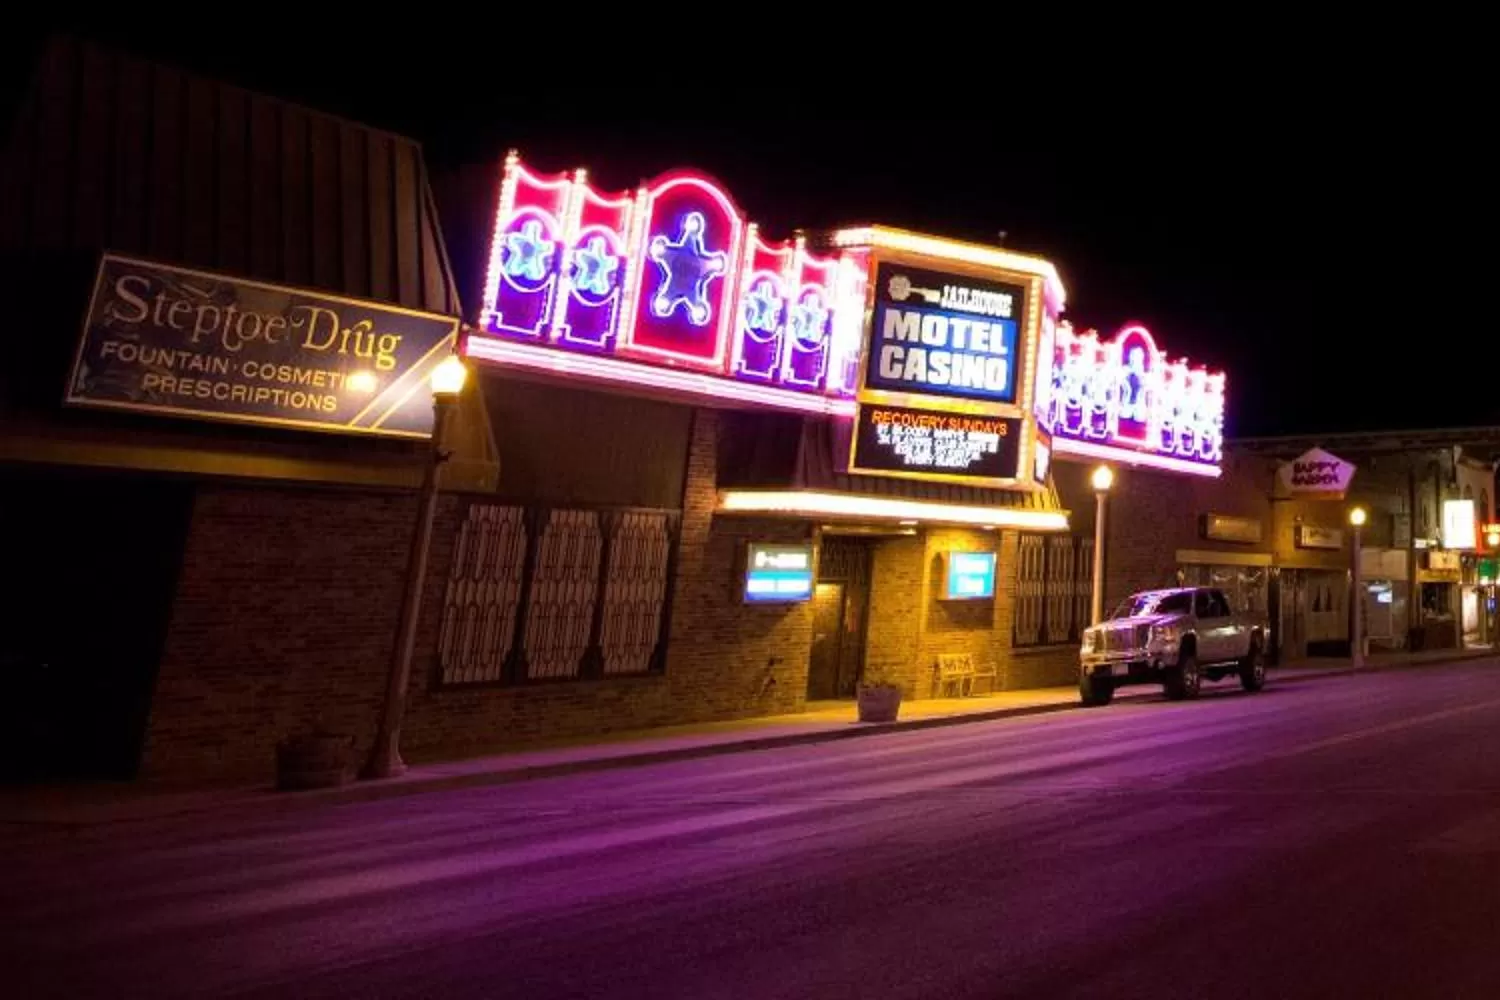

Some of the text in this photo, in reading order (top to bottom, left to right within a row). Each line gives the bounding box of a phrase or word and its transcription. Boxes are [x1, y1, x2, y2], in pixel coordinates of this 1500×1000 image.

[111, 275, 403, 371] Steptoe Drug
[883, 308, 1008, 355] MOTEL
[101, 341, 376, 392] FOUNTAIN COSMETI
[879, 345, 1008, 391] CASINO
[141, 373, 338, 412] PRESCRIPTIONS
[871, 410, 1008, 437] RECOVERY SUNDAYS
